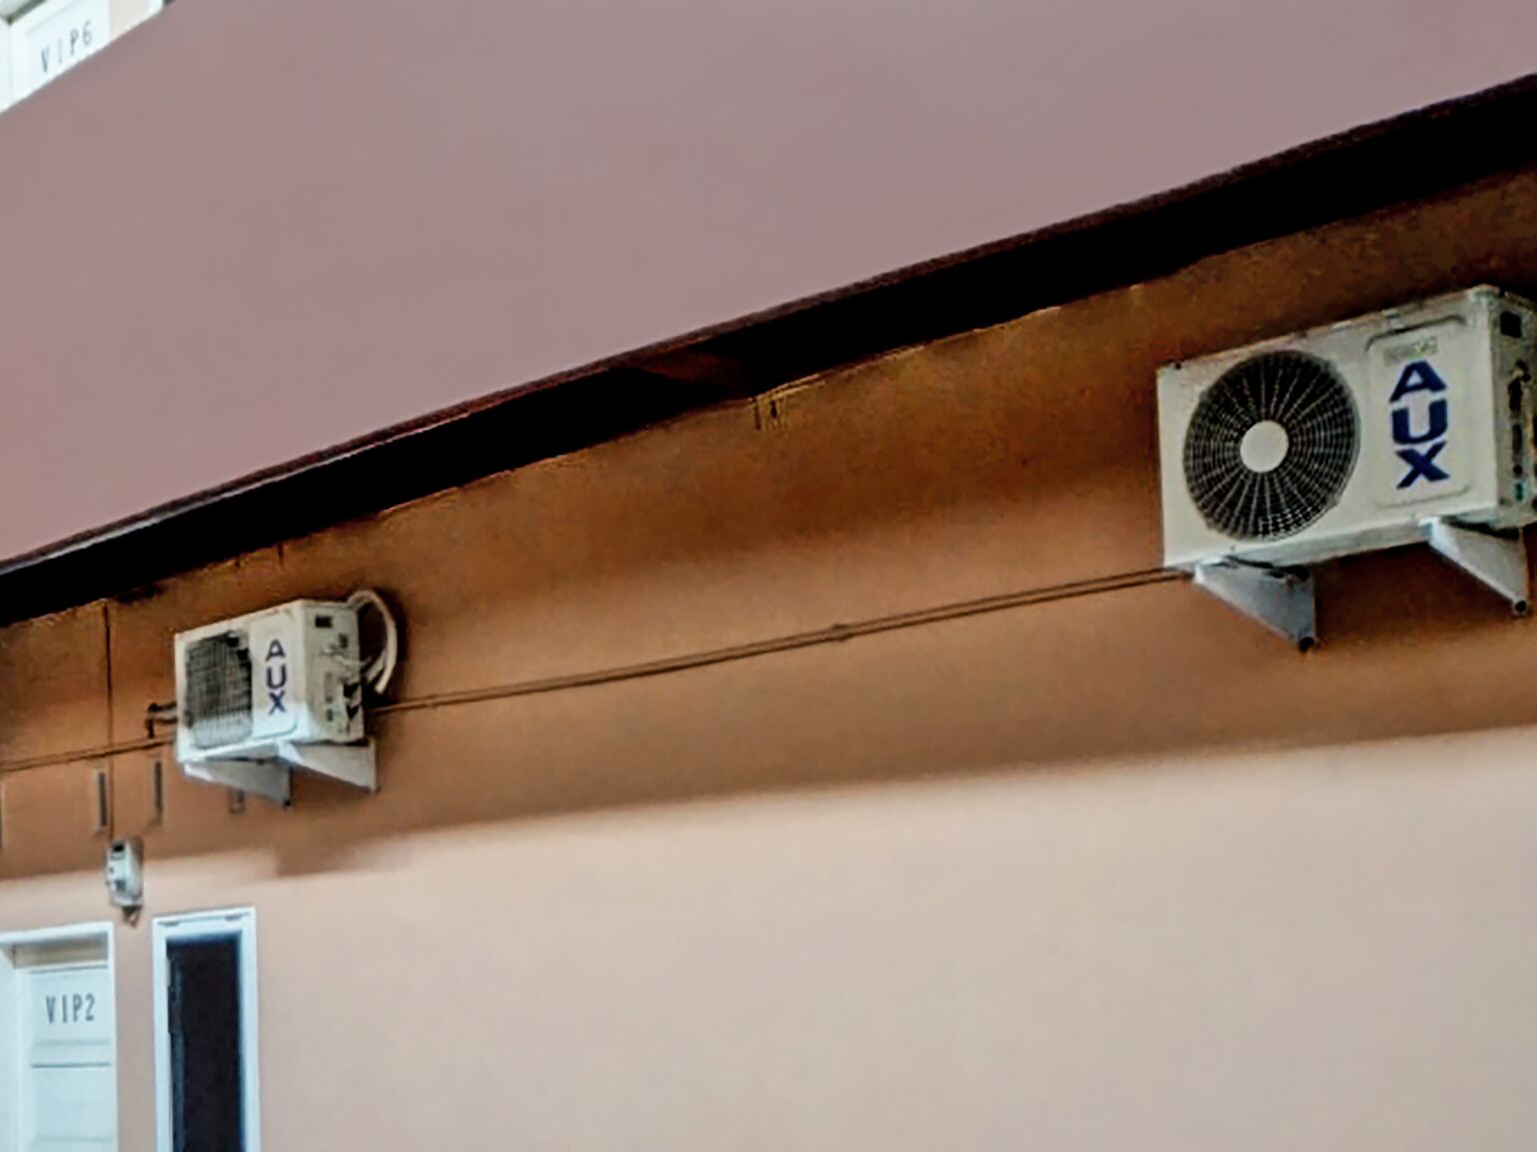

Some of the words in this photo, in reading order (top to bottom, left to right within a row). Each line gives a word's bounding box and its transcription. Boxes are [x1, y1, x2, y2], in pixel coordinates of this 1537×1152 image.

[41, 20, 93, 73] VIP6
[1389, 360, 1450, 490] AUX
[265, 638, 288, 716] AUX
[45, 992, 95, 1024] VIP2
